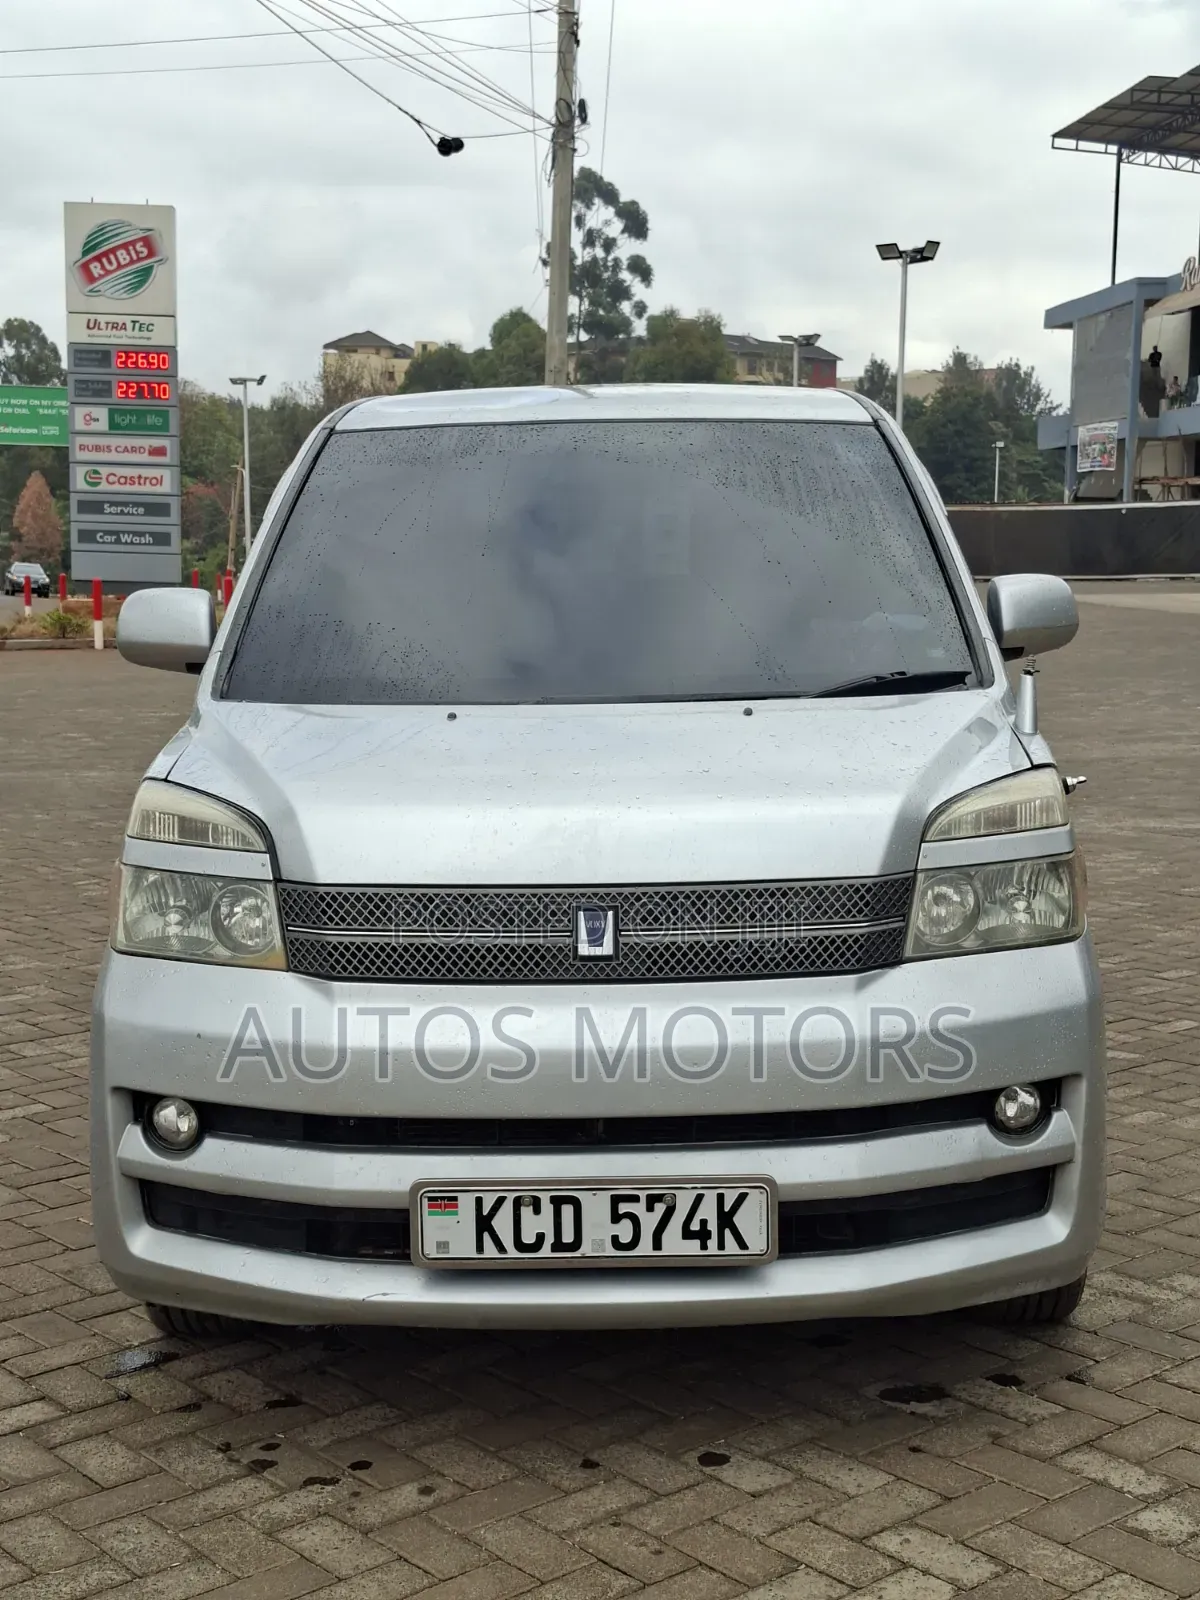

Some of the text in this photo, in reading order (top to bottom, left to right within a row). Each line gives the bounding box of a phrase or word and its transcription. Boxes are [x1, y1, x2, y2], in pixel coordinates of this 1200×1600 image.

[88, 241, 149, 278] RUBIS
[86, 318, 155, 332] ULTRA TEC
[78, 443, 146, 454] RUBIS CARD
[105, 472, 164, 487] Castrol
[103, 503, 145, 514] Service
[96, 532, 154, 544] Car Wash
[474, 1194, 583, 1255] KCD
[610, 1191, 750, 1252] 574K
